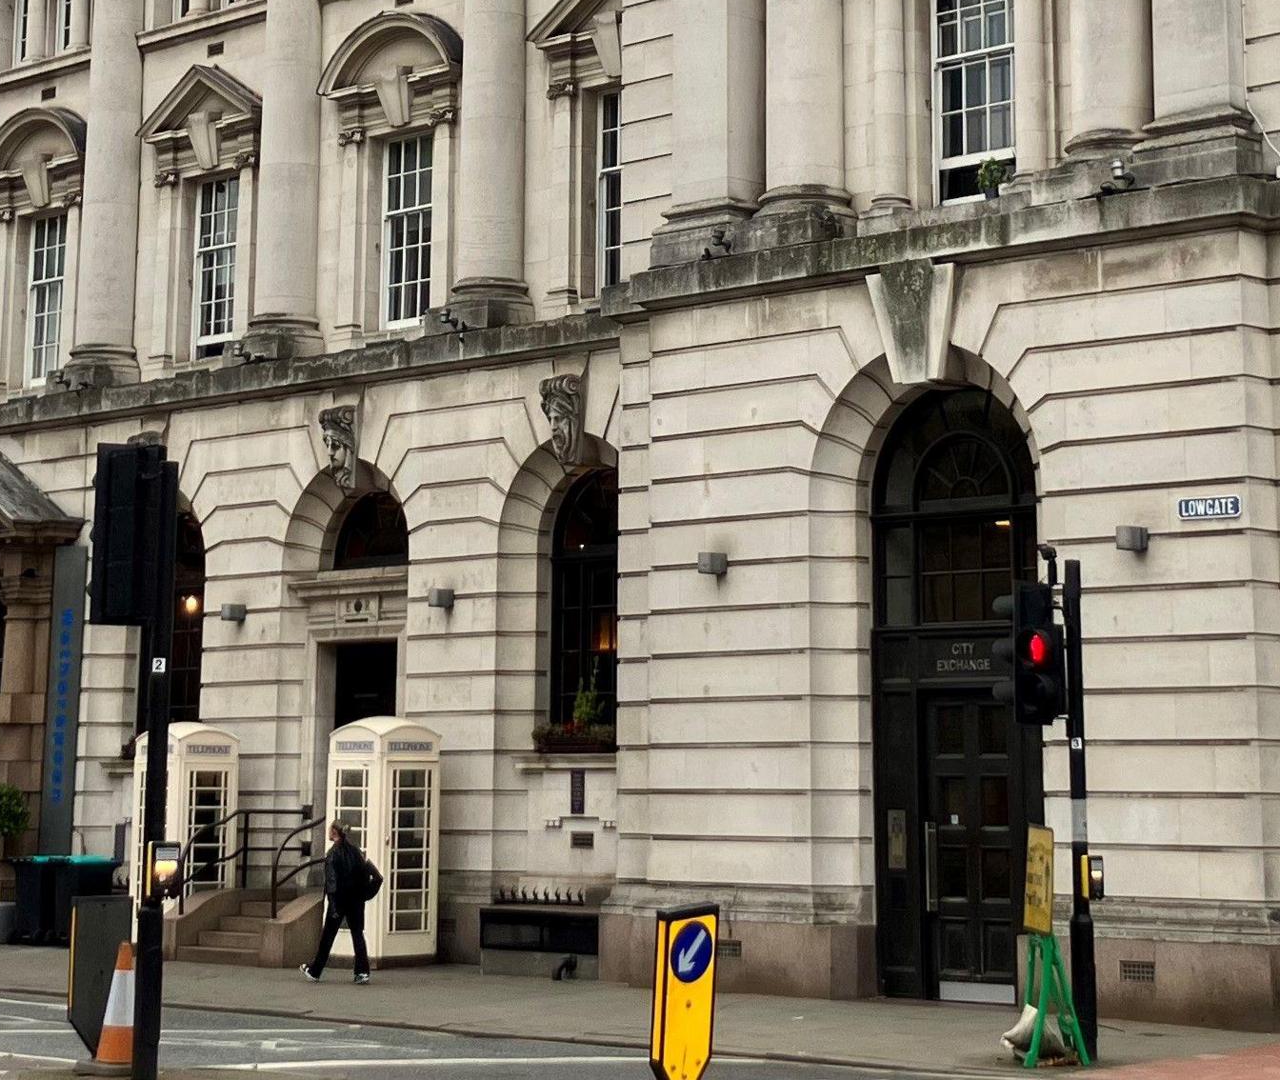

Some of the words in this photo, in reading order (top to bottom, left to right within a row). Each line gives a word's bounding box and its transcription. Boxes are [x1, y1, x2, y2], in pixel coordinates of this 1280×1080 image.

[1181, 498, 1235, 516] LOWGATE
[952, 643, 974, 655] CITY
[937, 659, 991, 671] EXCHANGE
[187, 745, 231, 754] TELEPHONE
[389, 743, 432, 752] TELEPHONE
